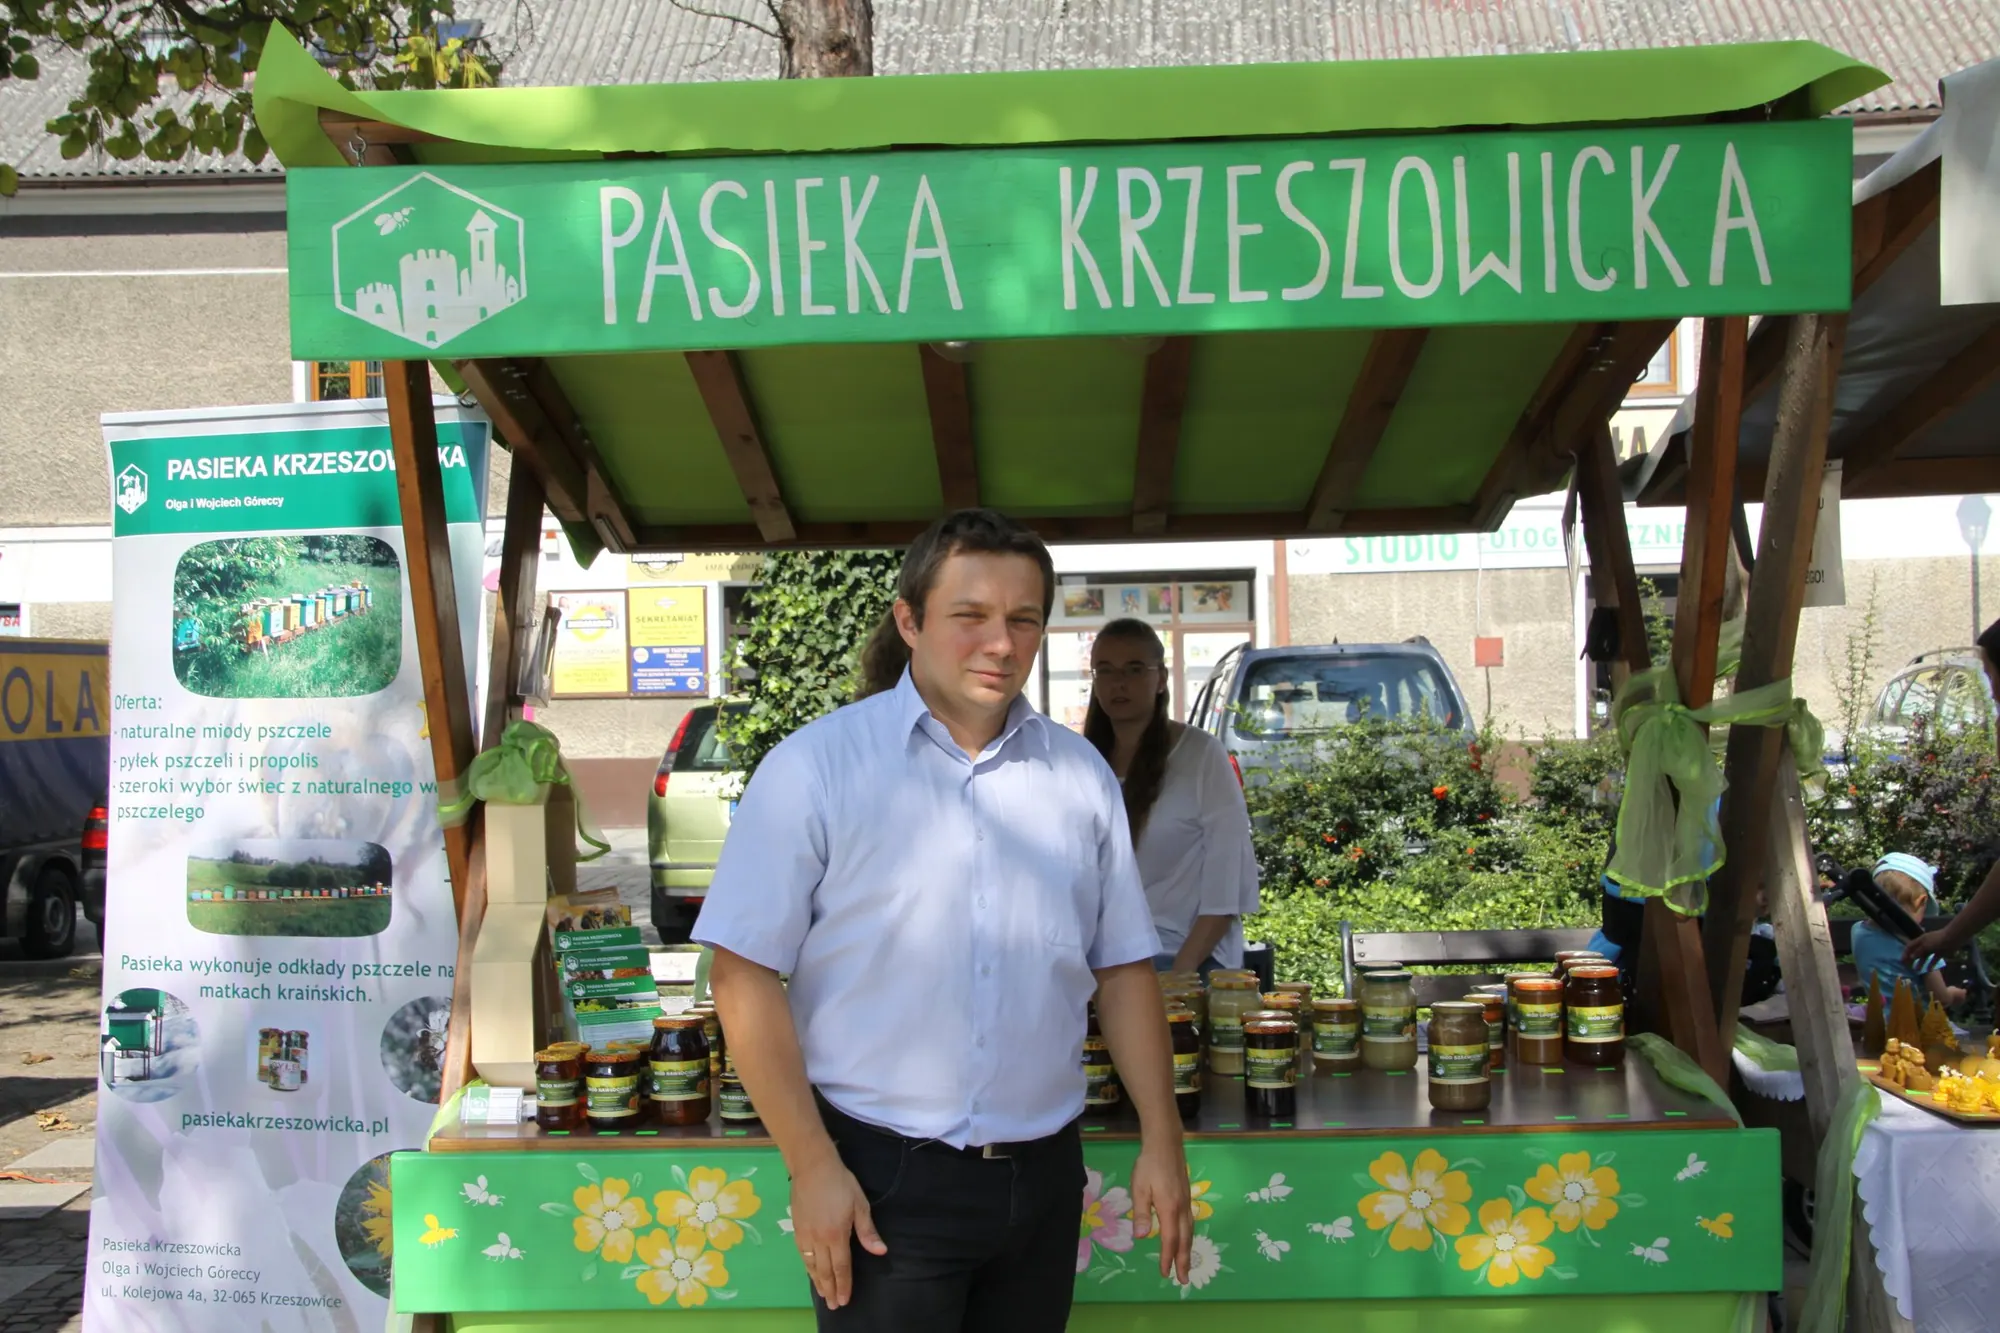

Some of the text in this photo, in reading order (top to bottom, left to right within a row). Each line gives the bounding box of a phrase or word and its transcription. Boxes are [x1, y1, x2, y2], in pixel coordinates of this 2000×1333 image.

[600, 141, 1772, 325] PASIEKA KRZESZOWICKA
[167, 446, 467, 481] PASIEKA KRZESZOKA
[166, 498, 189, 511] Olga
[196, 497, 242, 509] Wojciech
[244, 495, 284, 510] Góreccy
[1345, 534, 1460, 566] STUDIO
[2, 666, 100, 735] OLA
[114, 695, 163, 711] Oferta:
[121, 722, 332, 742] naturalne miody pszczele
[119, 753, 158, 772] pyłek
[165, 752, 233, 772] pszczeli
[250, 752, 319, 772] propolis
[119, 778, 174, 794] szeroki
[180, 778, 233, 797] wybór
[238, 777, 285, 794] świec
[292, 782, 301, 794] z
[307, 778, 413, 799] naturalnego
[117, 804, 205, 823] pszczelego
[121, 955, 455, 981] Pasieka wykonuje odkłady pszczele na
[200, 983, 373, 1003] matkach kraińskich.
[182, 1111, 389, 1137] pasiekakrzeszowicka.pl
[103, 1238, 241, 1256] Pasieka Krzeszowicka
[102, 1261, 131, 1278] Olga
[145, 1263, 203, 1279] Wojciech
[207, 1265, 261, 1284] Góreccy
[101, 1285, 342, 1309] ul. Kolejowa 4a, 32-065 Krzeszowice
